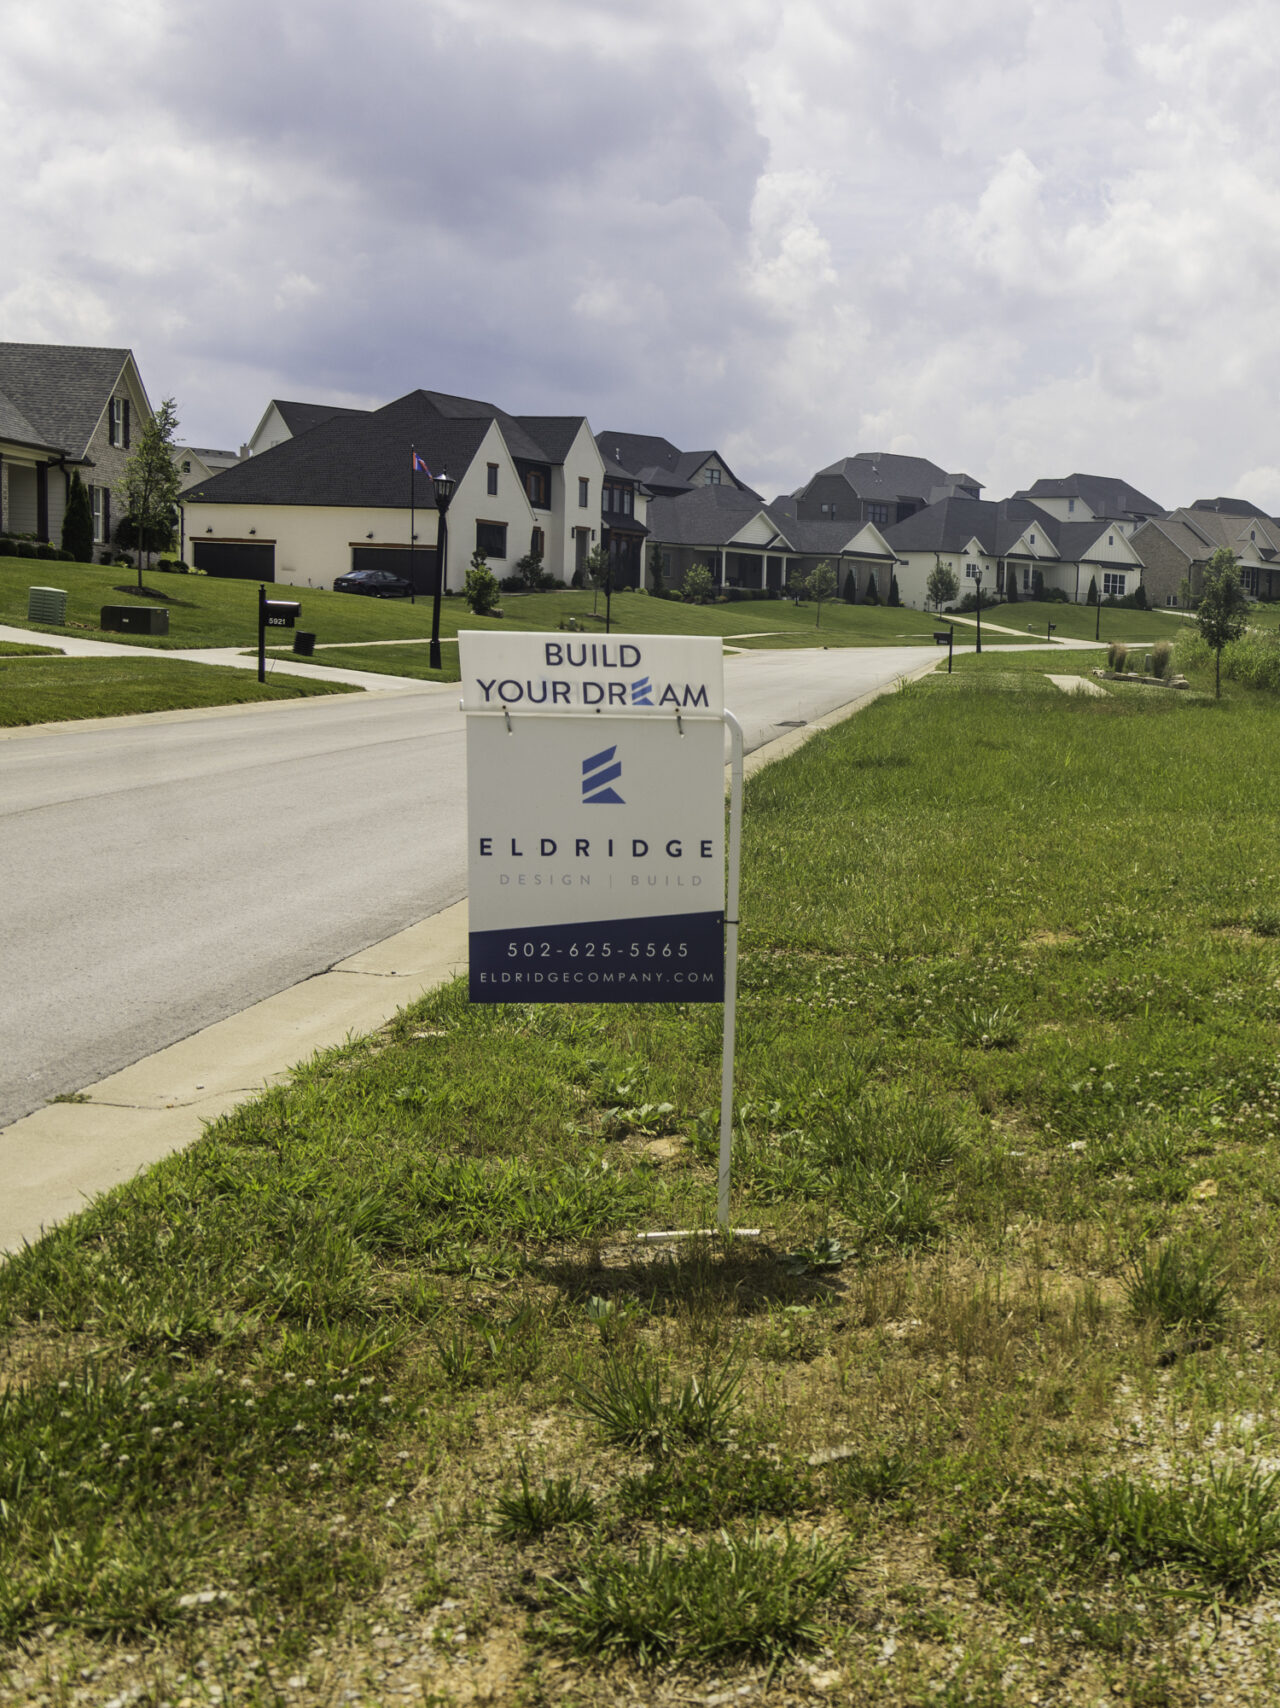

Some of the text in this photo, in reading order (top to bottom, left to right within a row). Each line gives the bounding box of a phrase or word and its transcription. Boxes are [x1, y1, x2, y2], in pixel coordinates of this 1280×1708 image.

[545, 643, 642, 668] BUILD
[476, 676, 710, 707] YOUR DREAM
[479, 838, 713, 858] ELDRIDGE
[499, 873, 702, 887] DESIGN BUILD
[507, 942, 688, 957] 502-625-5565
[480, 972, 714, 983] ELDRIDGECOMPANY.COM
